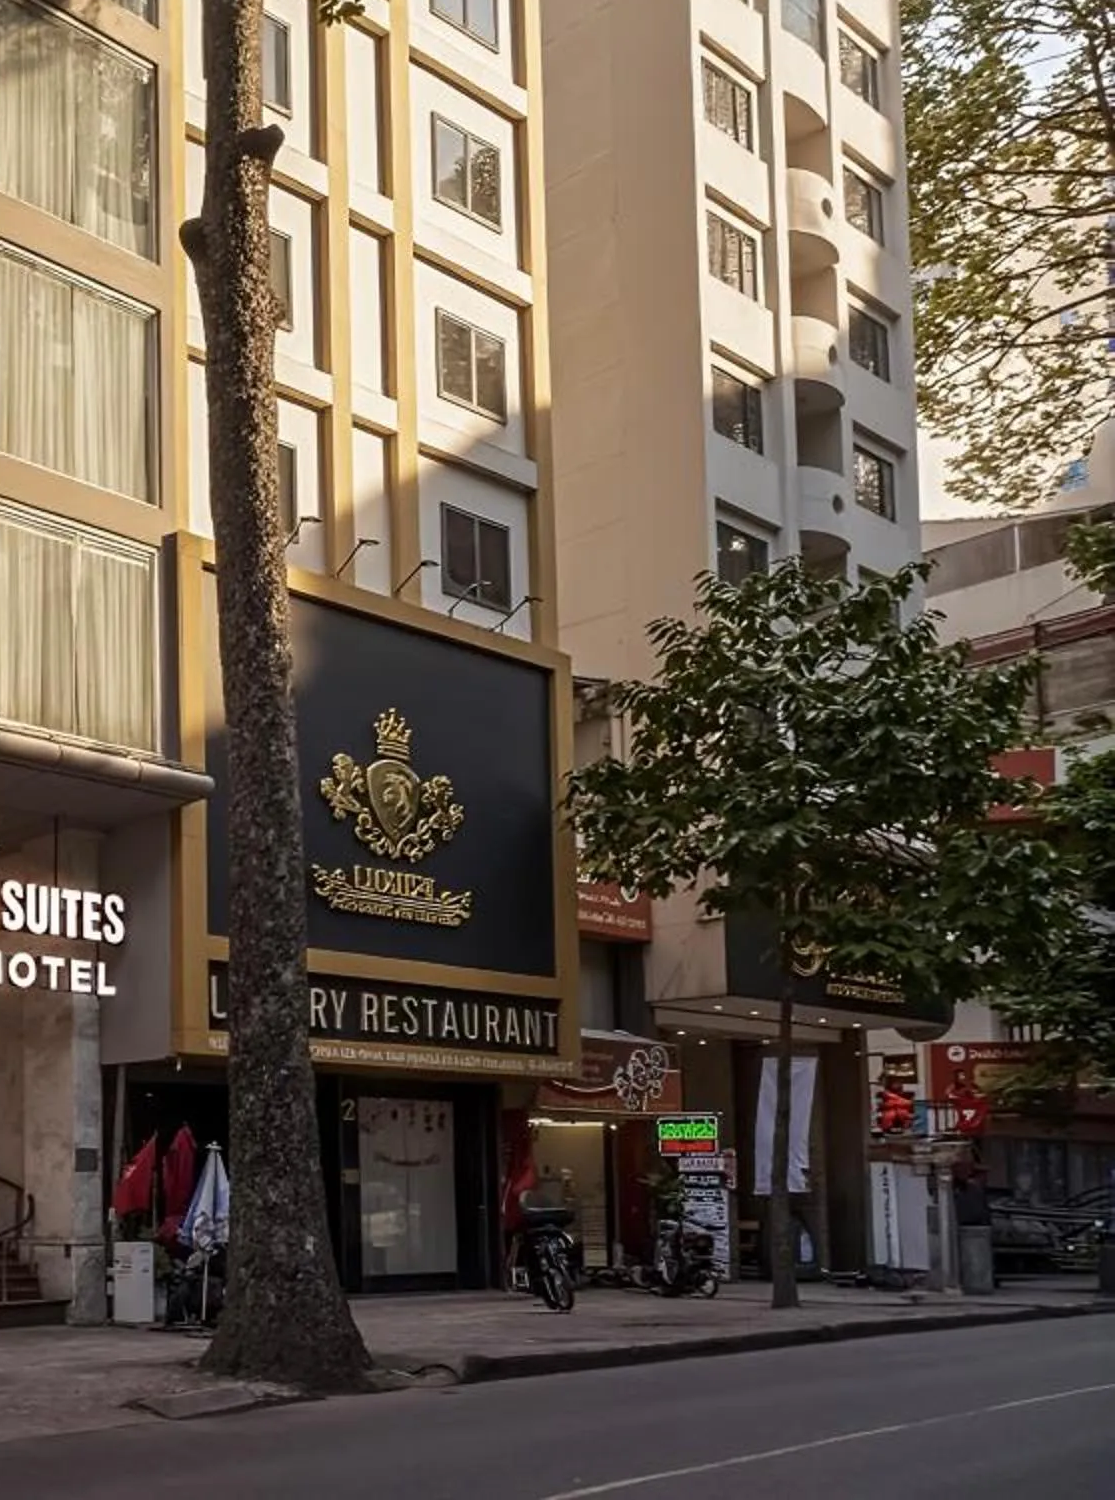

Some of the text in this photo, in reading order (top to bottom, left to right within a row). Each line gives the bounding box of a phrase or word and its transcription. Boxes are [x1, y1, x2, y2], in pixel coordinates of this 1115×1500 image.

[1, 879, 126, 945] SUITES
[211, 975, 558, 1048] LRY RESTAURANT
